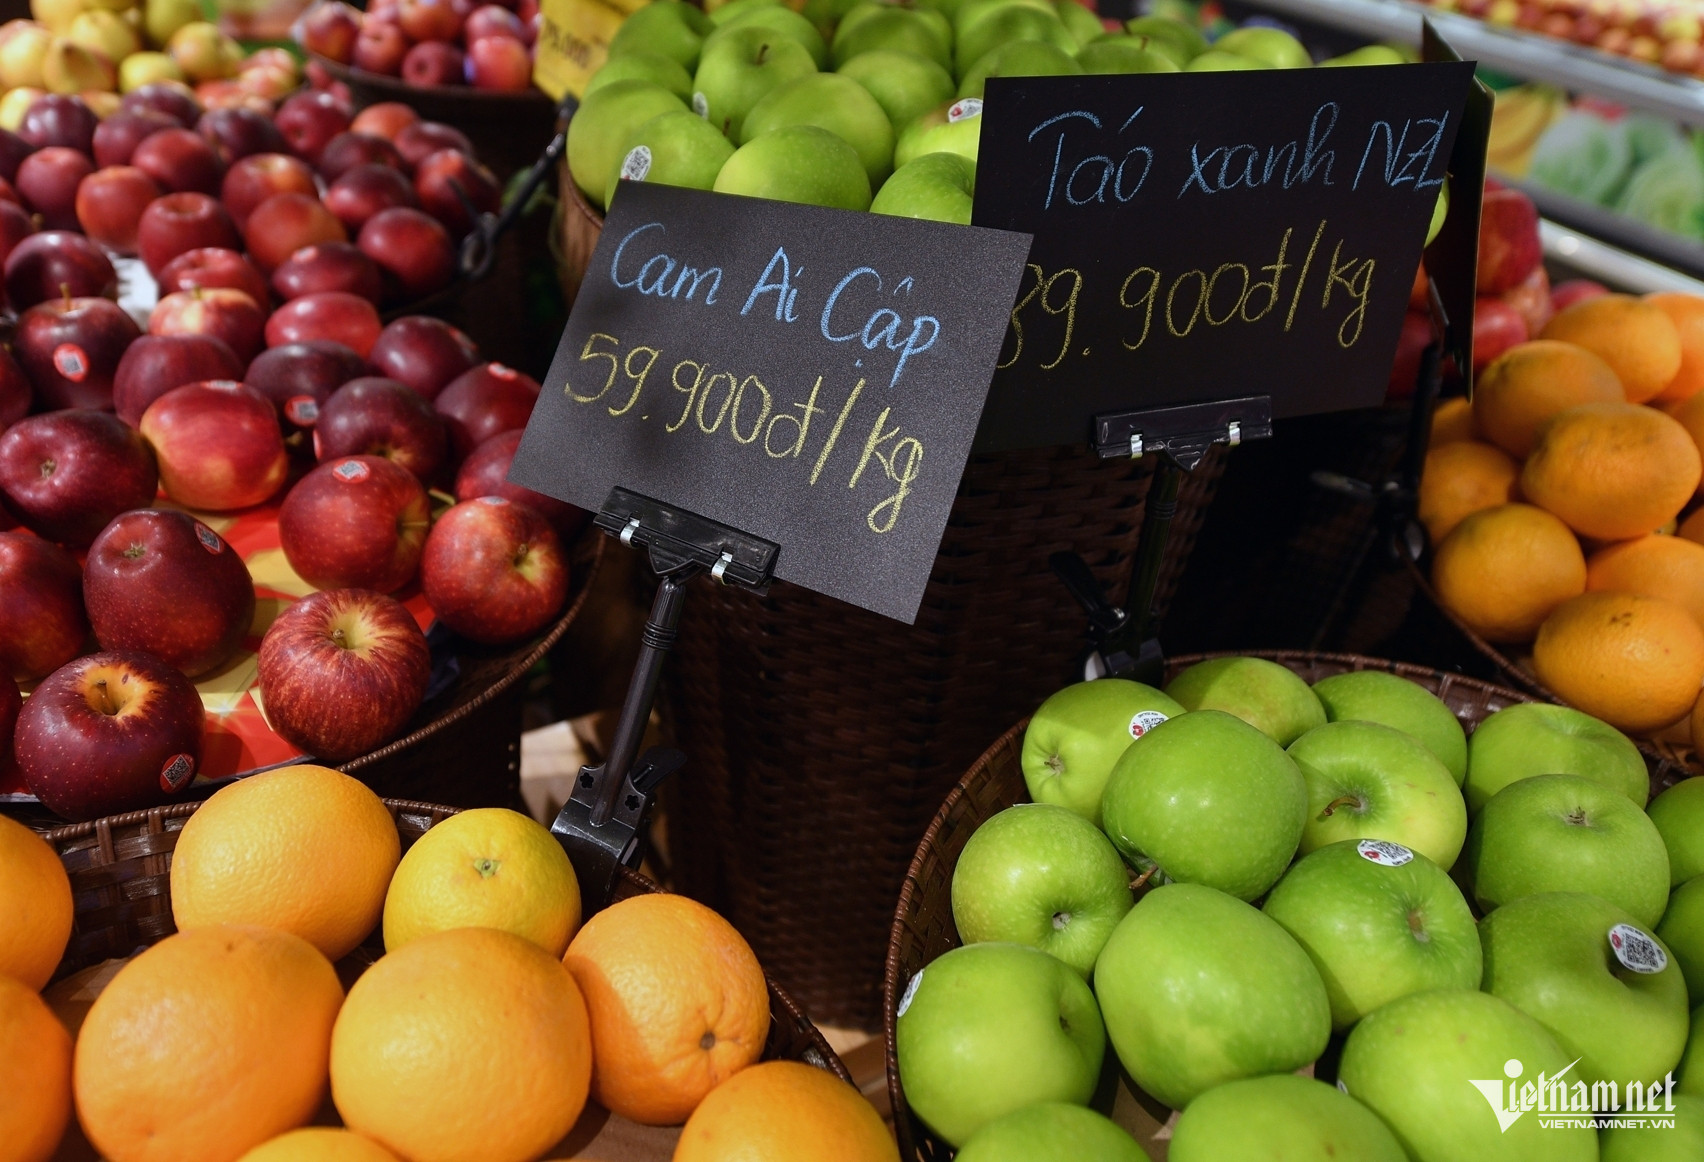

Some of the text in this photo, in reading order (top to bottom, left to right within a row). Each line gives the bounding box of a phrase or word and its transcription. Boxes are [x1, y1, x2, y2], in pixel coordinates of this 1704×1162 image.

[1177, 102, 1336, 200] xanh
[611, 222, 723, 305] Cam
[820, 265, 941, 389] Cập
